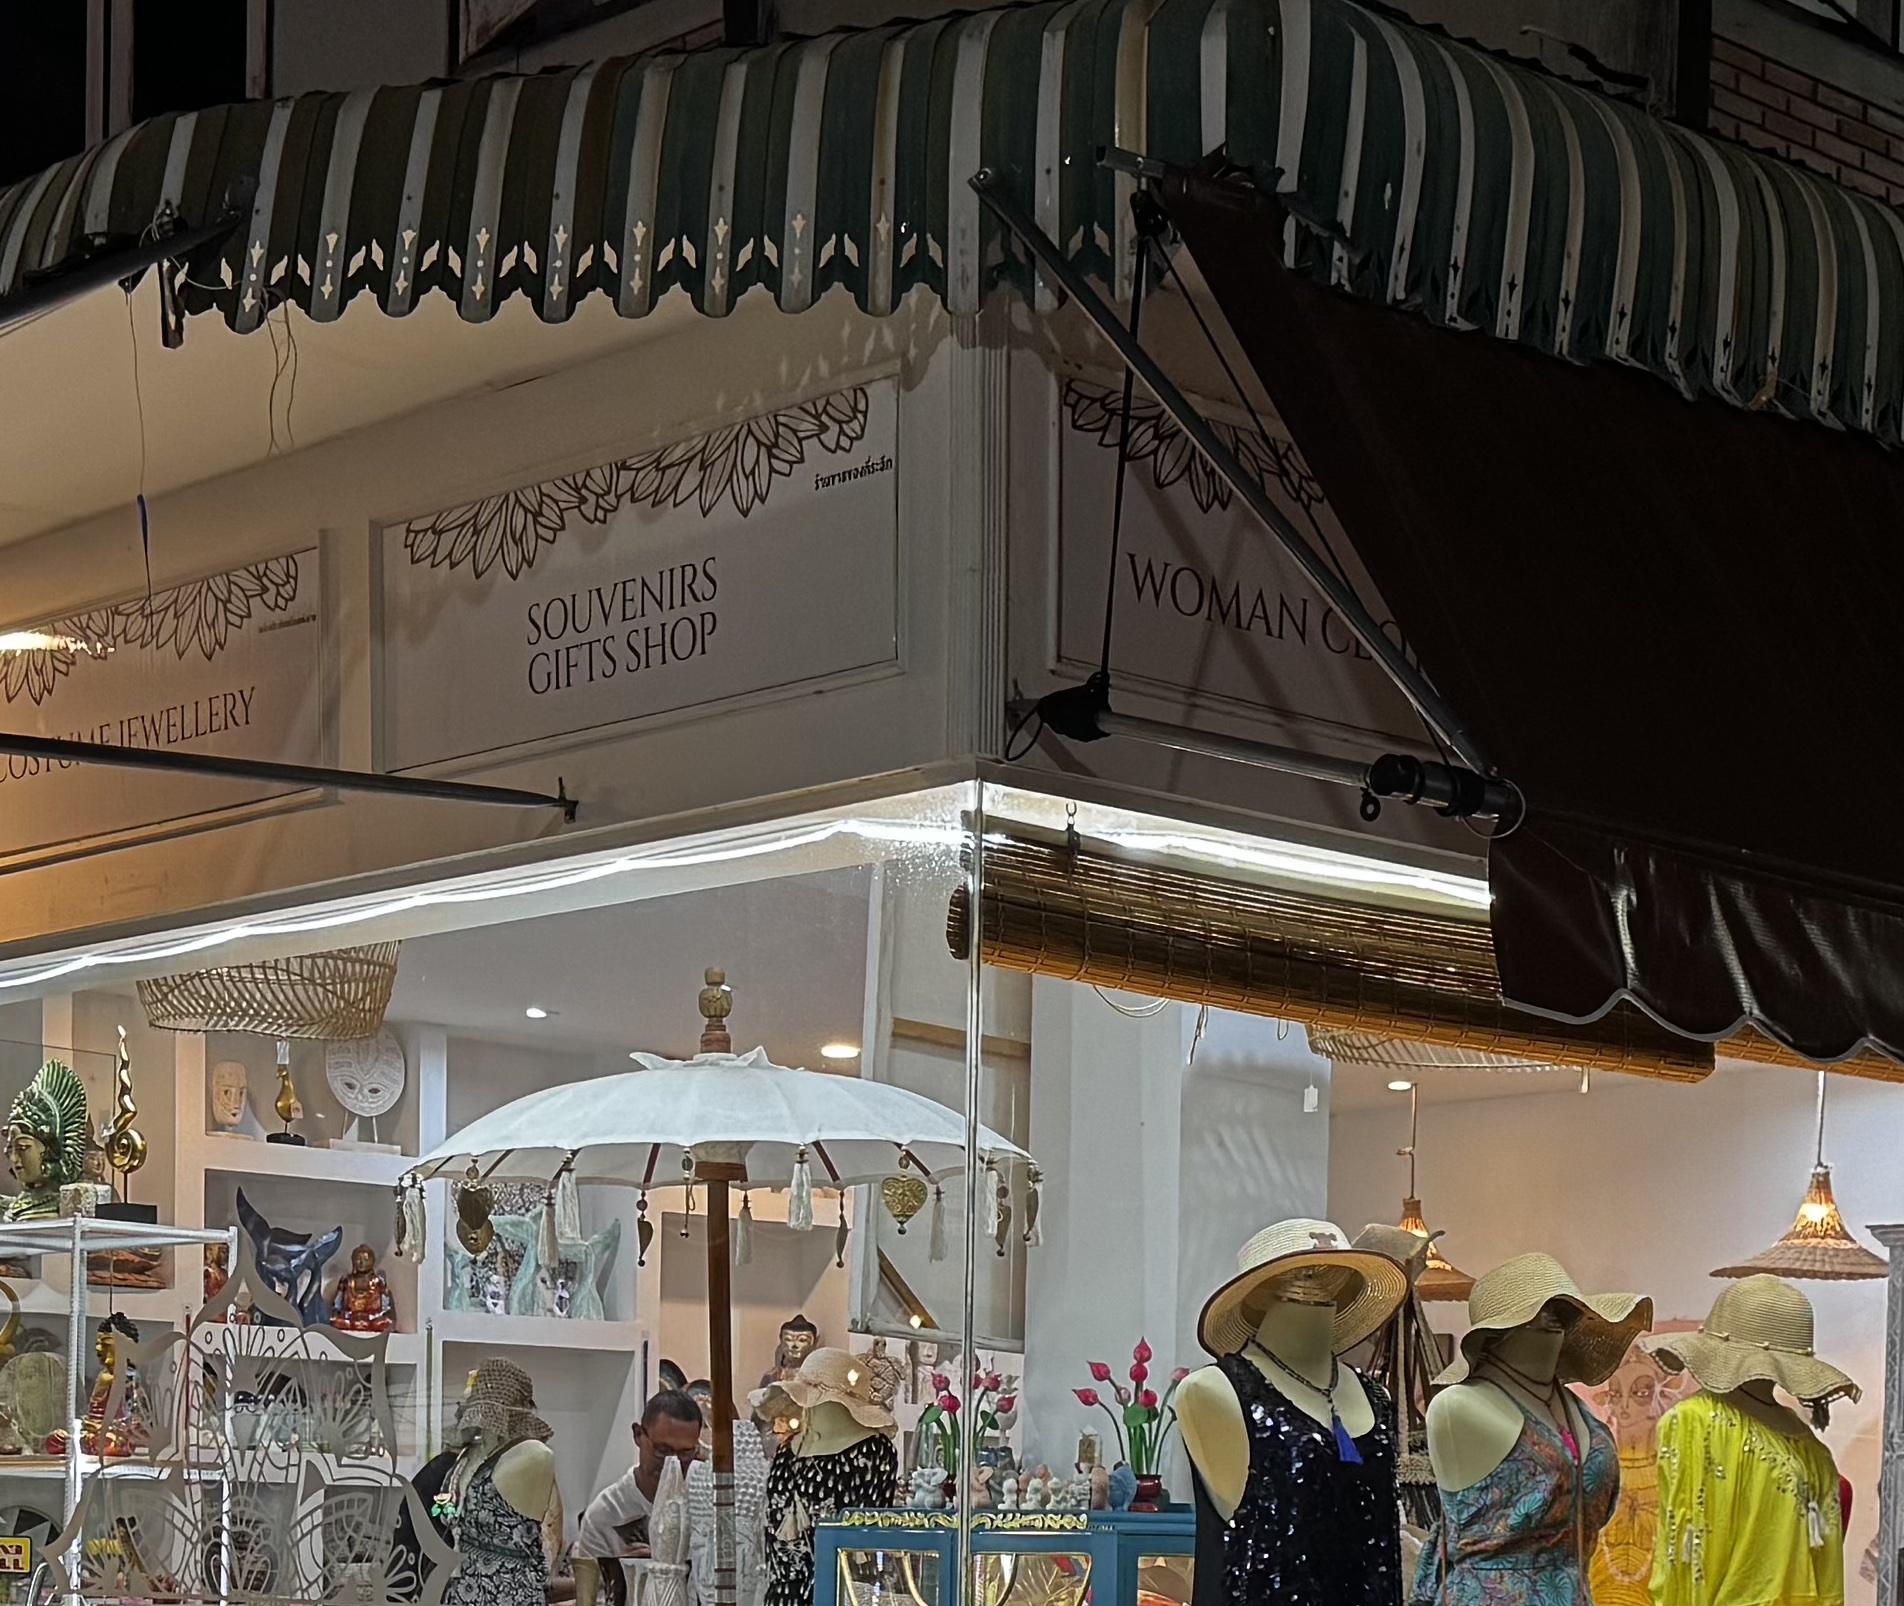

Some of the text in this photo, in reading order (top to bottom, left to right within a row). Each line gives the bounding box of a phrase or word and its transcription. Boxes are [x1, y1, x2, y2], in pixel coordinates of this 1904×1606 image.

[527, 557, 718, 645] SOUVENIRS
[1127, 552, 1308, 645] WOMAN
[528, 611, 718, 695] GIFTS SHOP
[119, 686, 256, 751] JEWELLERY
